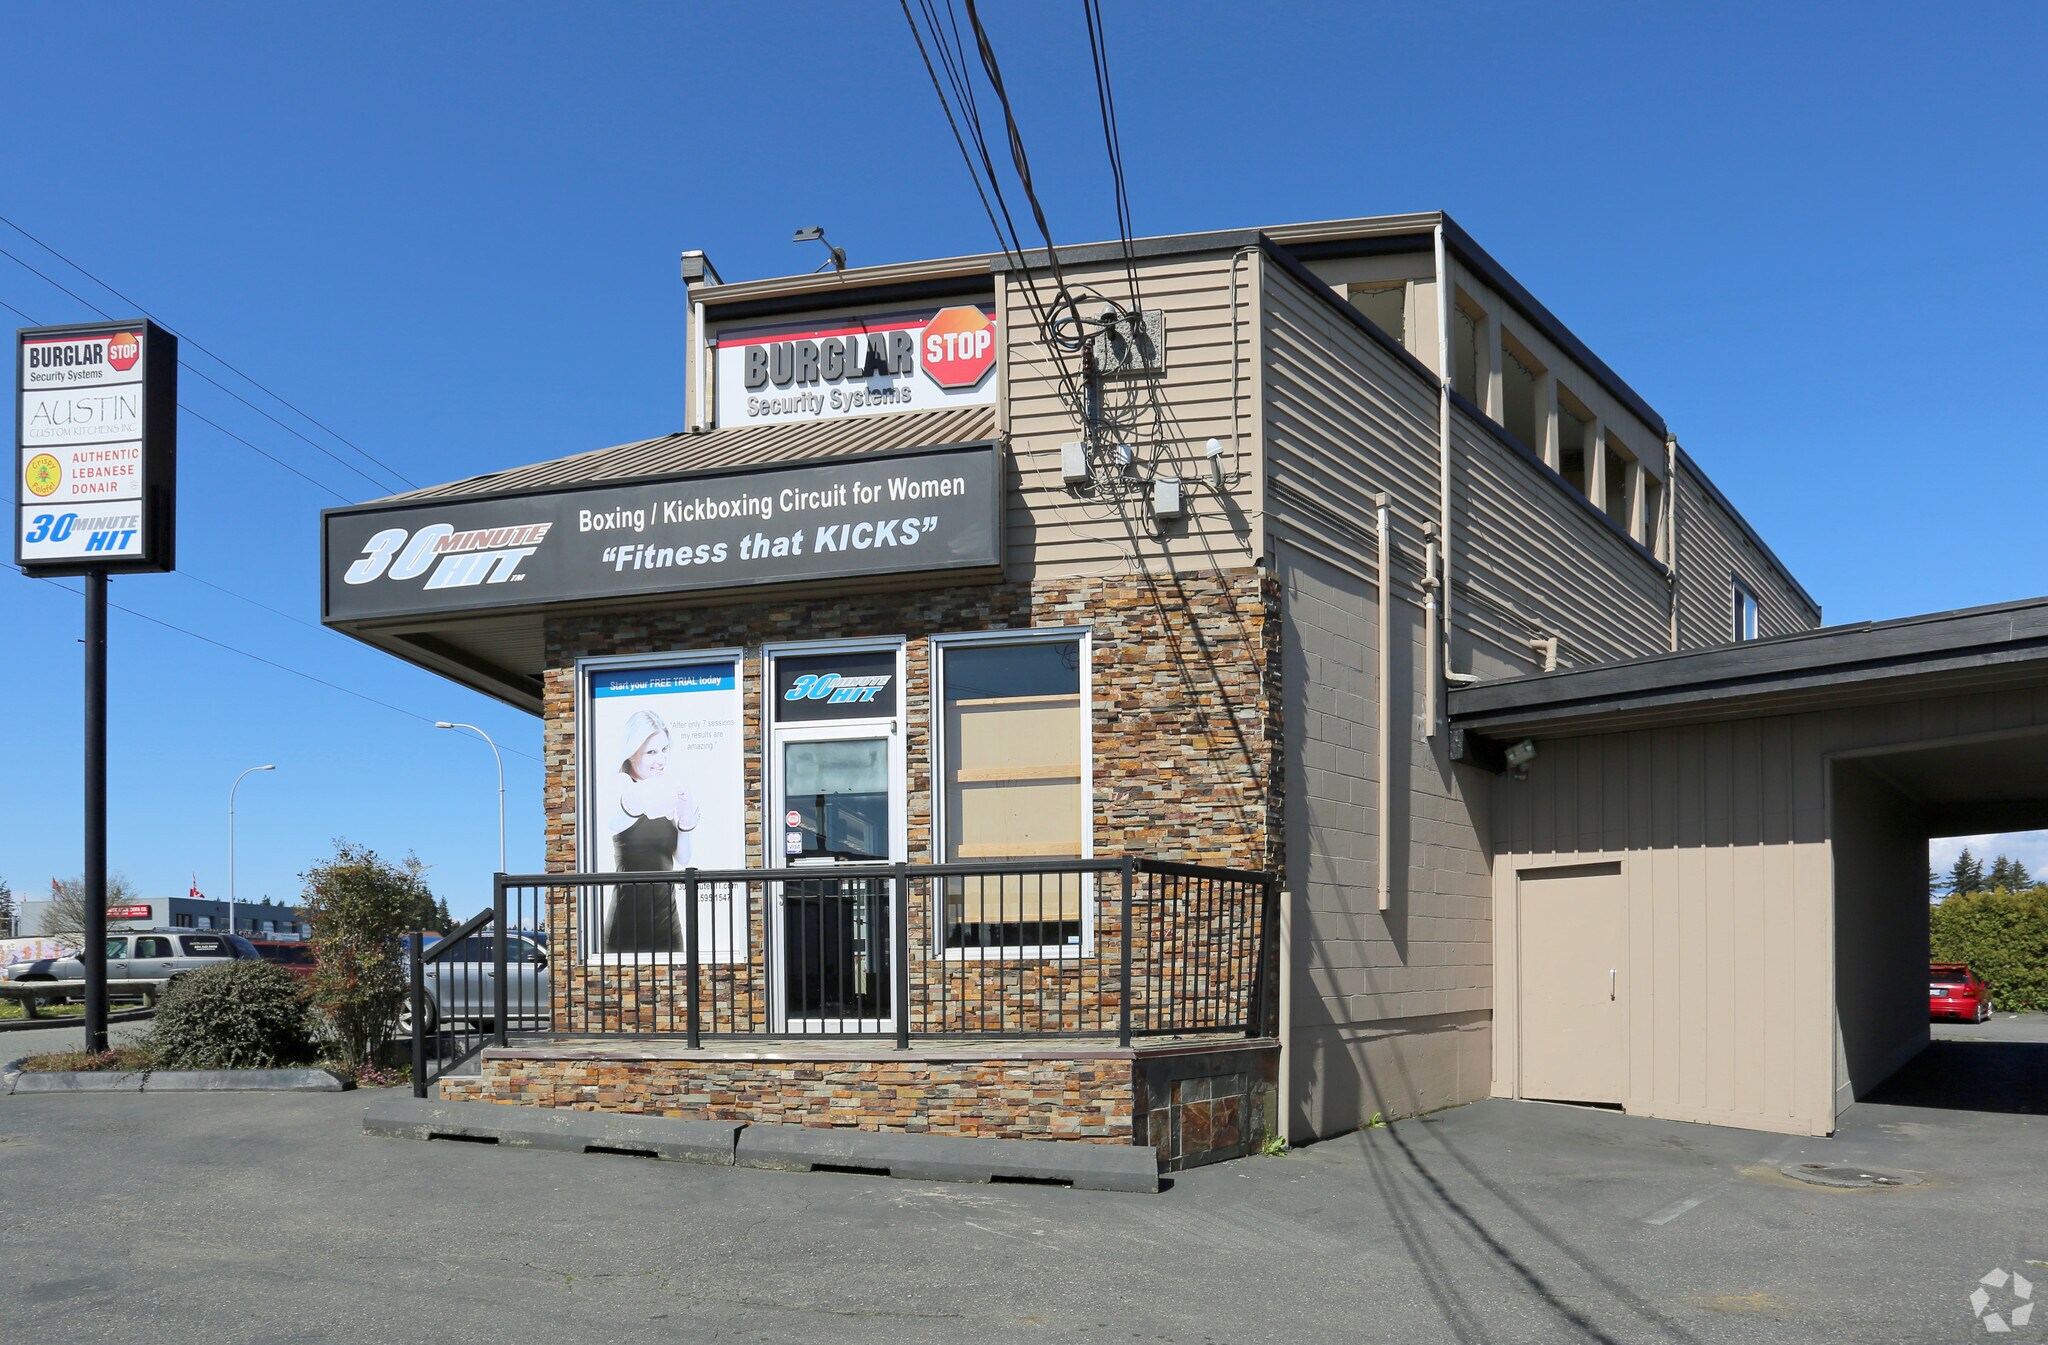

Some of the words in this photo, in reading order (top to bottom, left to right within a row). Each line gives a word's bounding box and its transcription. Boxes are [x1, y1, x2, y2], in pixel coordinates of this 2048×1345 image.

[29, 343, 103, 368] BURGLAR
[110, 343, 138, 360] STOP
[744, 330, 914, 390] BURGLAR
[926, 329, 991, 364] STOP
[29, 371, 65, 382] Security
[67, 369, 103, 381] Systems
[30, 394, 137, 426] AUSTIN
[746, 393, 824, 417] Security
[830, 384, 912, 412] Systems
[29, 427, 71, 438] CUSTOM
[73, 424, 119, 435] KITCHENS
[121, 422, 136, 432] INC
[32, 458, 57, 470] Crispy
[72, 448, 139, 463] AUTHENTIC
[72, 464, 135, 479] LEBANESE
[33, 481, 56, 494] Falafel
[72, 481, 118, 495] DONAIR
[579, 506, 645, 533] Boxing
[663, 492, 773, 524] Kickboxing
[779, 483, 847, 512] Circuit
[852, 481, 882, 505] for
[887, 476, 965, 501] Women
[25, 512, 78, 543] 30
[71, 515, 140, 531] MINUTE
[84, 530, 137, 552] HIT
[602, 543, 728, 572] “Fitness
[739, 528, 804, 560] that
[813, 516, 938, 553] KICKS”
[344, 523, 455, 584] 30
[432, 522, 553, 553] MINUTE
[423, 546, 537, 590] HIT
[610, 681, 629, 691] Start
[630, 681, 649, 691] your
[650, 677, 672, 688] FREE
[673, 676, 698, 686] TRIAL
[699, 675, 722, 686] today
[784, 673, 842, 701] 30
[828, 675, 892, 687] MINUTE
[826, 686, 884, 704] HIT
[688, 720, 700, 729] only
[702, 719, 707, 727] 7
[708, 718, 735, 727] sessions
[680, 733, 691, 741] my
[692, 730, 712, 739] results
[714, 730, 724, 738] are
